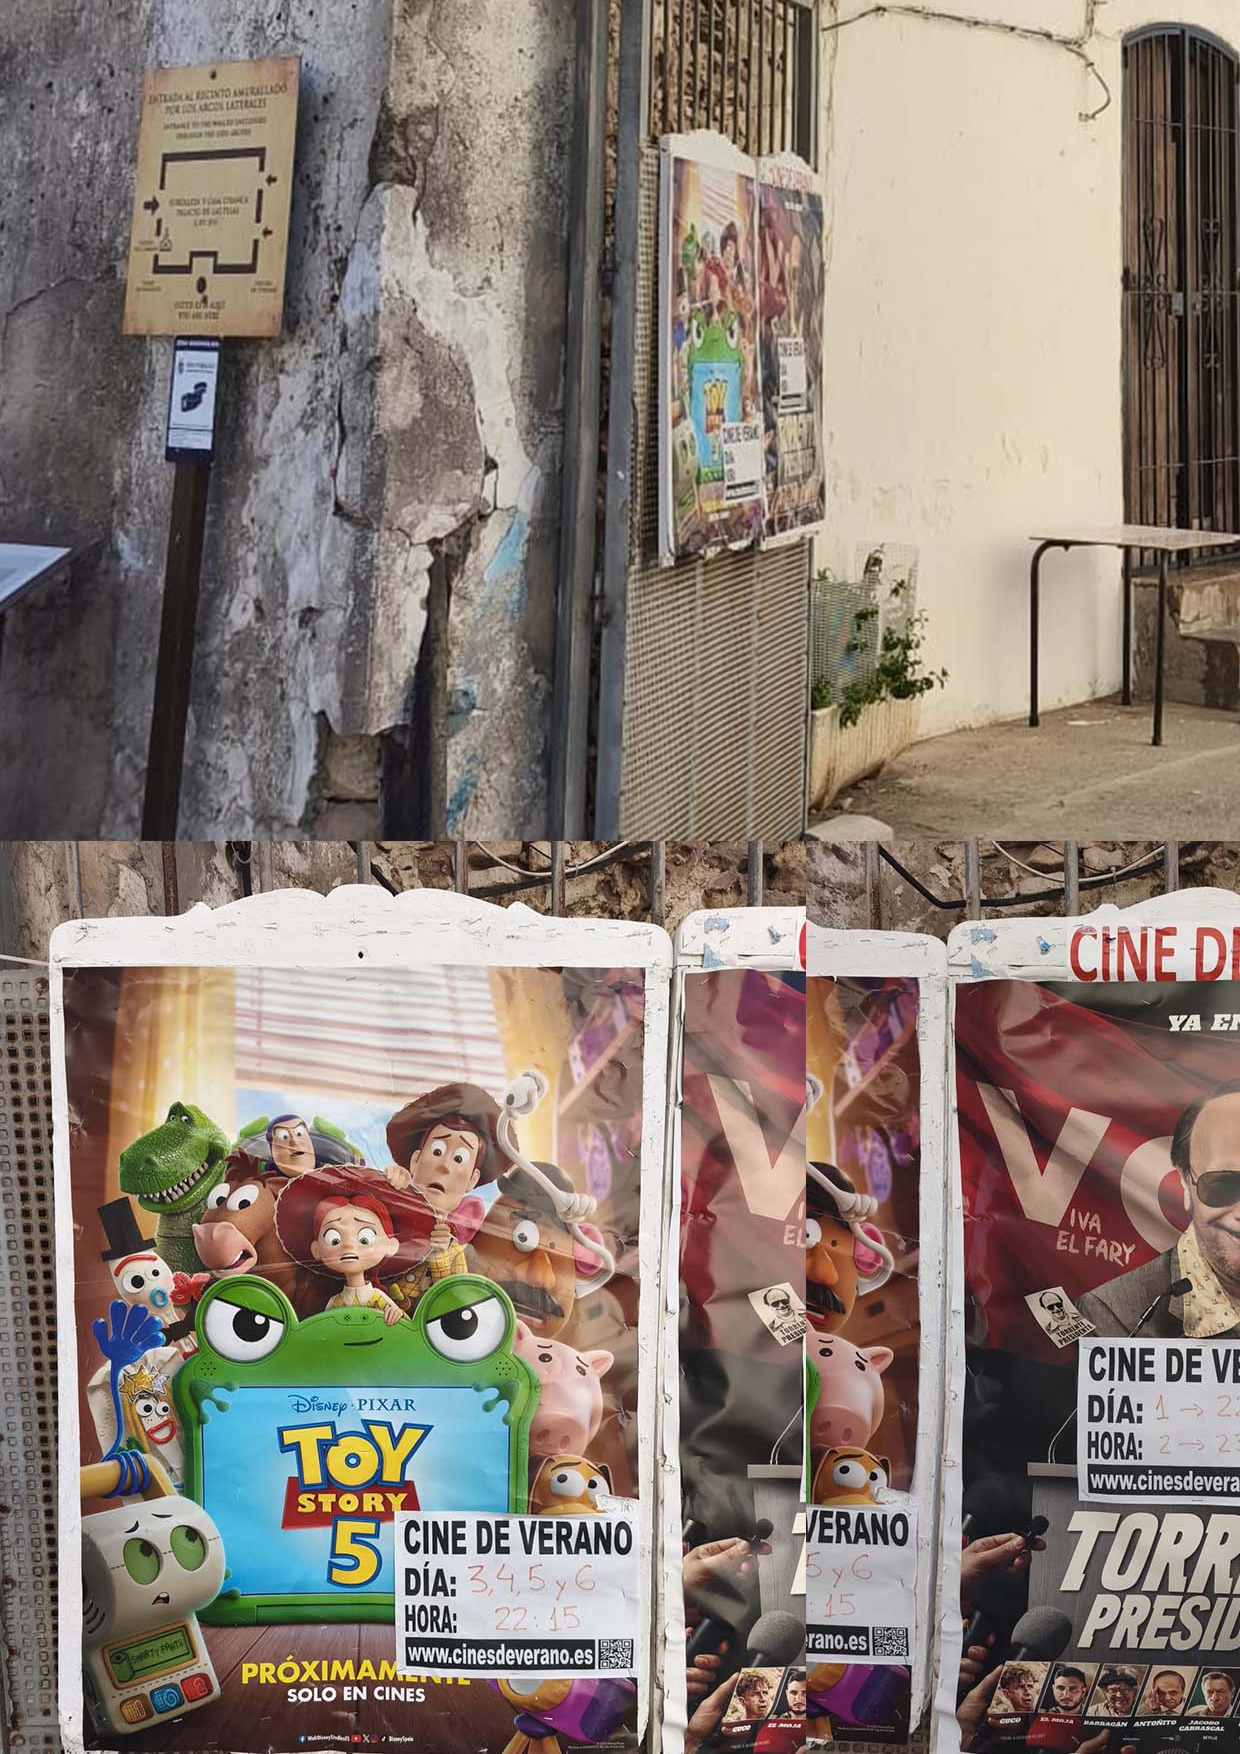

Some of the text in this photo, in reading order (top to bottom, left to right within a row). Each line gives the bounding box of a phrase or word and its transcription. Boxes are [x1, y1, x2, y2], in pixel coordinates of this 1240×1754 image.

[1069, 925, 1177, 982] CINE
[1168, 1014, 1202, 1031] YA
[1056, 1230, 1136, 1267] EL FARY
[1056, 1321, 1086, 1338] TORRENTE
[1058, 1324, 1094, 1345] PRESIDENTE
[1088, 1346, 1155, 1382] CINE
[1165, 1347, 1203, 1383] DE
[358, 1398, 416, 1412] PIXAR
[1087, 1388, 1143, 1424] DÍA:
[277, 1419, 434, 1491] TOY
[1087, 1430, 1143, 1461] HORA:
[297, 1493, 409, 1513] STORY
[404, 1519, 633, 1556] CINE DE VERANO
[327, 1516, 383, 1589] 5
[851, 1553, 872, 1580] 6
[404, 1561, 457, 1597] DÍA:
[575, 1564, 596, 1591] 6
[405, 1604, 457, 1633] HORA:
[408, 1643, 594, 1666] www.cinesdeverano.es
[287, 1686, 425, 1703] SOLO EN CINES
[731, 1724, 751, 1733] CUCO
[778, 1722, 802, 1730] MOJA
[999, 1717, 1022, 1725] CUCO
[1051, 1717, 1075, 1725] MOJA
[1133, 1719, 1177, 1727] ANTOÑITO
